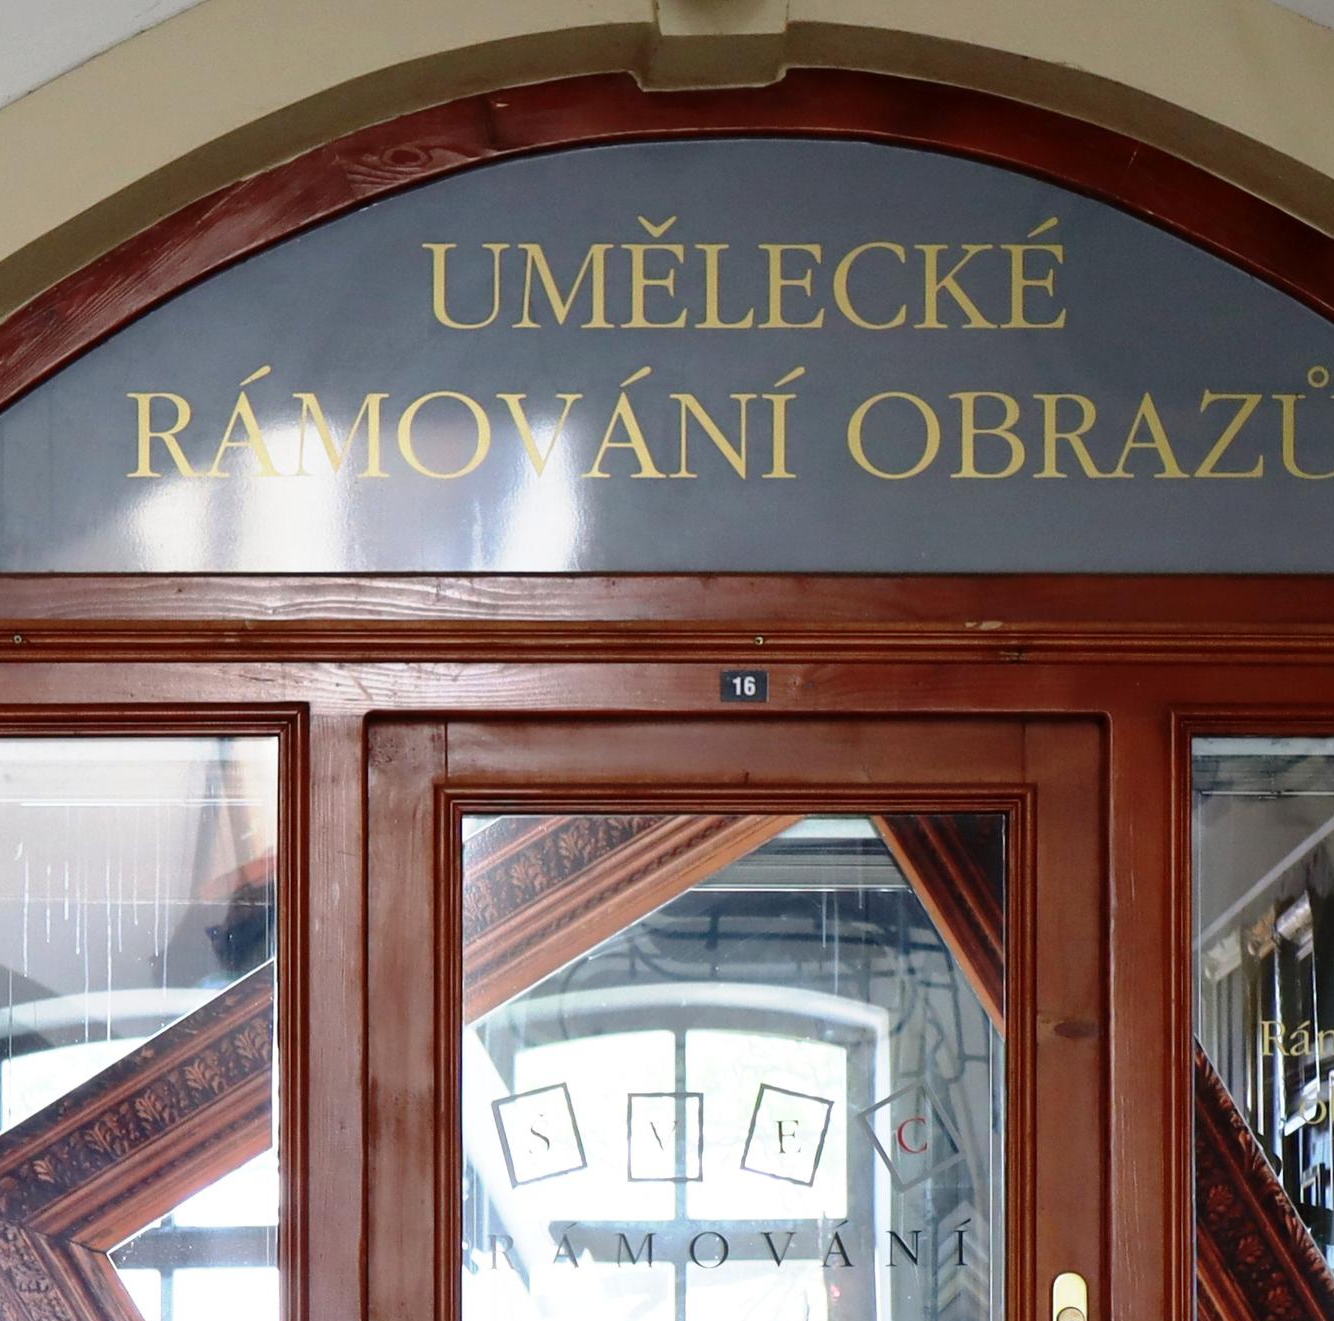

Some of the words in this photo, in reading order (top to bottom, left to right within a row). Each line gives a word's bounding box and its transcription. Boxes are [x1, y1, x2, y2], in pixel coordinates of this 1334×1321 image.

[422, 215, 1067, 331] UMĚLECKÉ
[125, 365, 806, 480] RÁMOVÁNÍ
[732, 676, 756, 696] 16
[488, 1218, 972, 1269] RÁMOVÁNÍ
